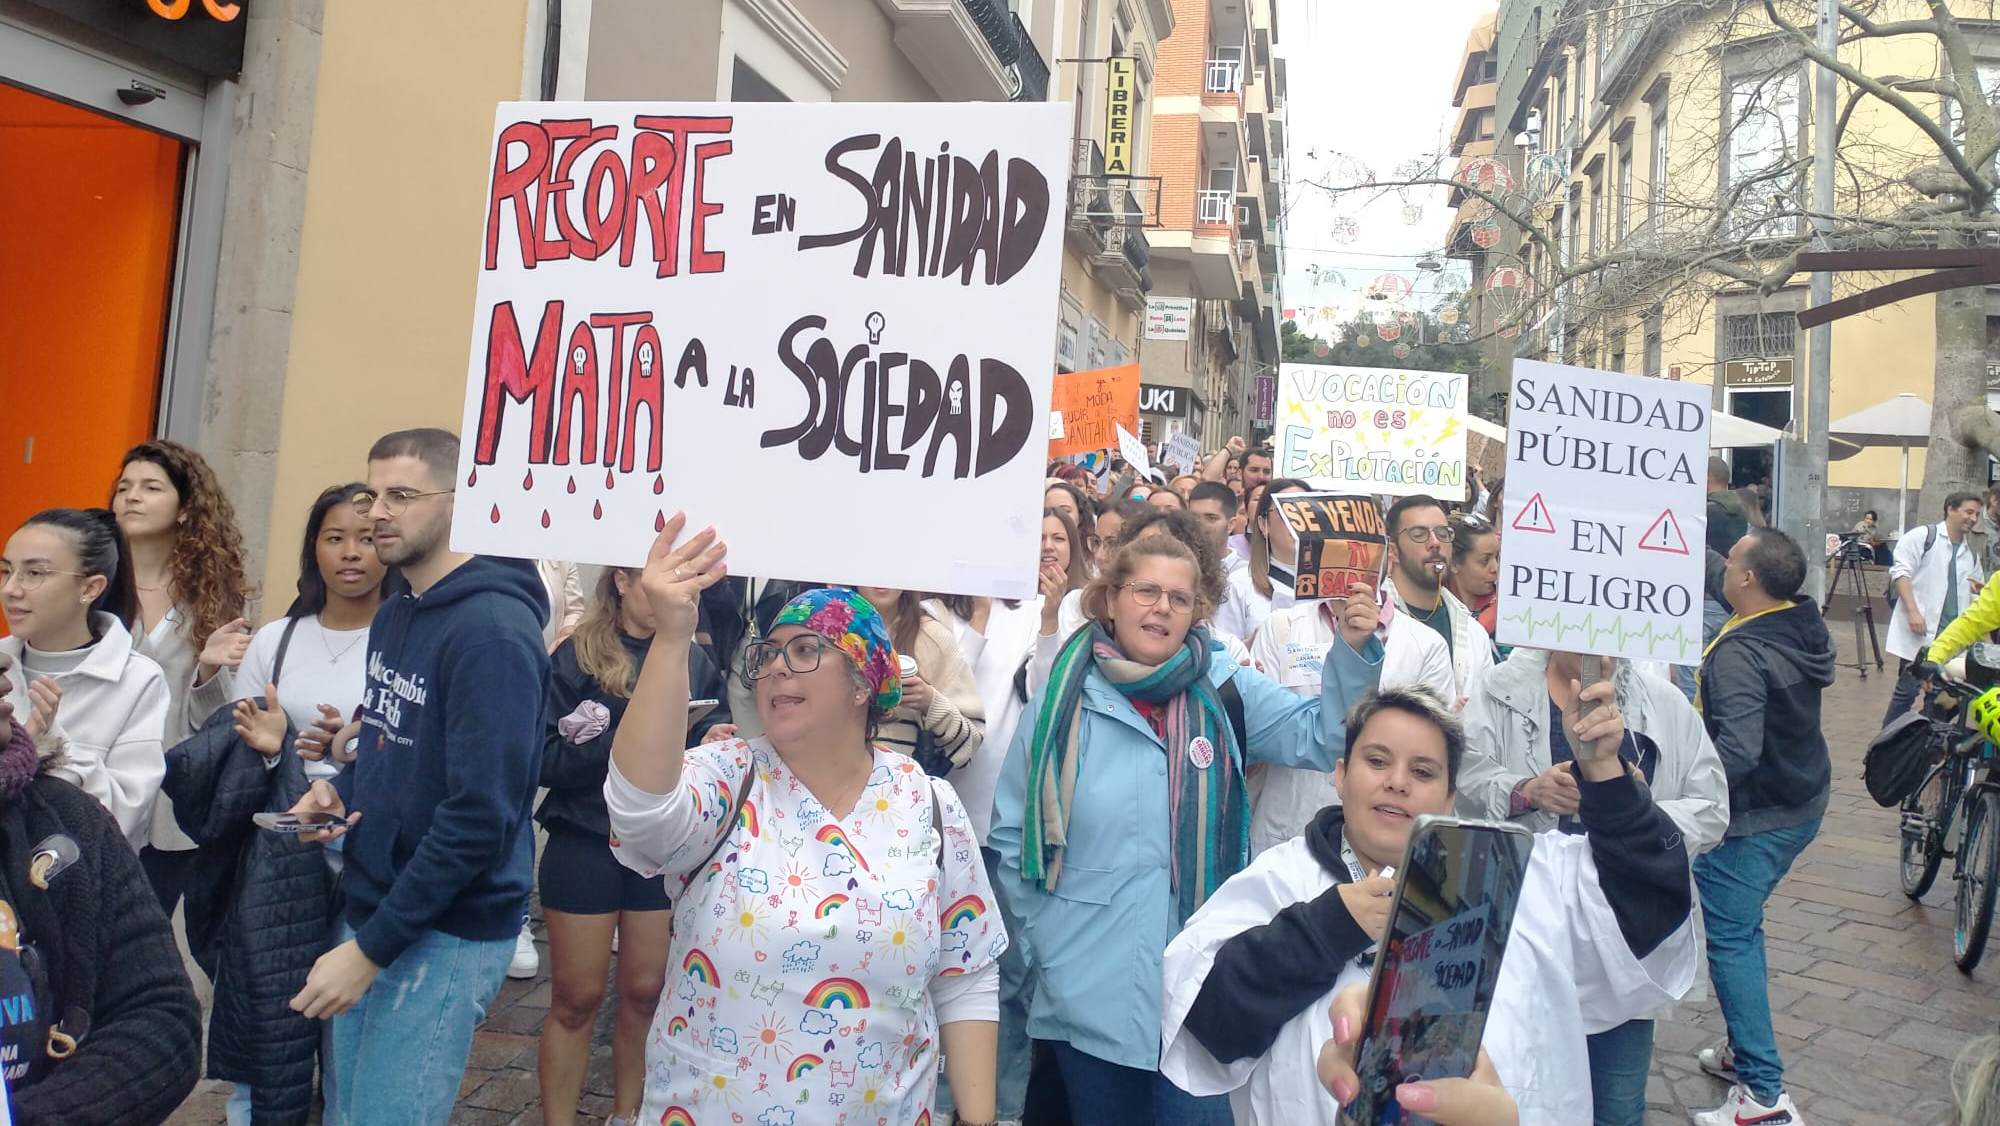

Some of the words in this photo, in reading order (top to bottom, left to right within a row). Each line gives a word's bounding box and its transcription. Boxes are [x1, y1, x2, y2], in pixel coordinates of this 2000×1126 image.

[1108, 62, 1129, 171] LIBRERIA
[485, 114, 733, 279] RECORTE
[751, 194, 796, 236] EN
[474, 301, 664, 473] MATA
[674, 337, 709, 389] A
[723, 364, 755, 409] LA
[1086, 391, 1114, 408] MODA
[1515, 378, 1704, 432] SANIDAD
[1327, 410, 1356, 429] no
[1374, 410, 1406, 429] es
[1514, 426, 1697, 485] PÚBLICA
[1282, 501, 1322, 532] SE
[1569, 519, 1627, 557] EN
[1509, 565, 1691, 617] PELIGRO
[397, 736, 414, 747] CITY
